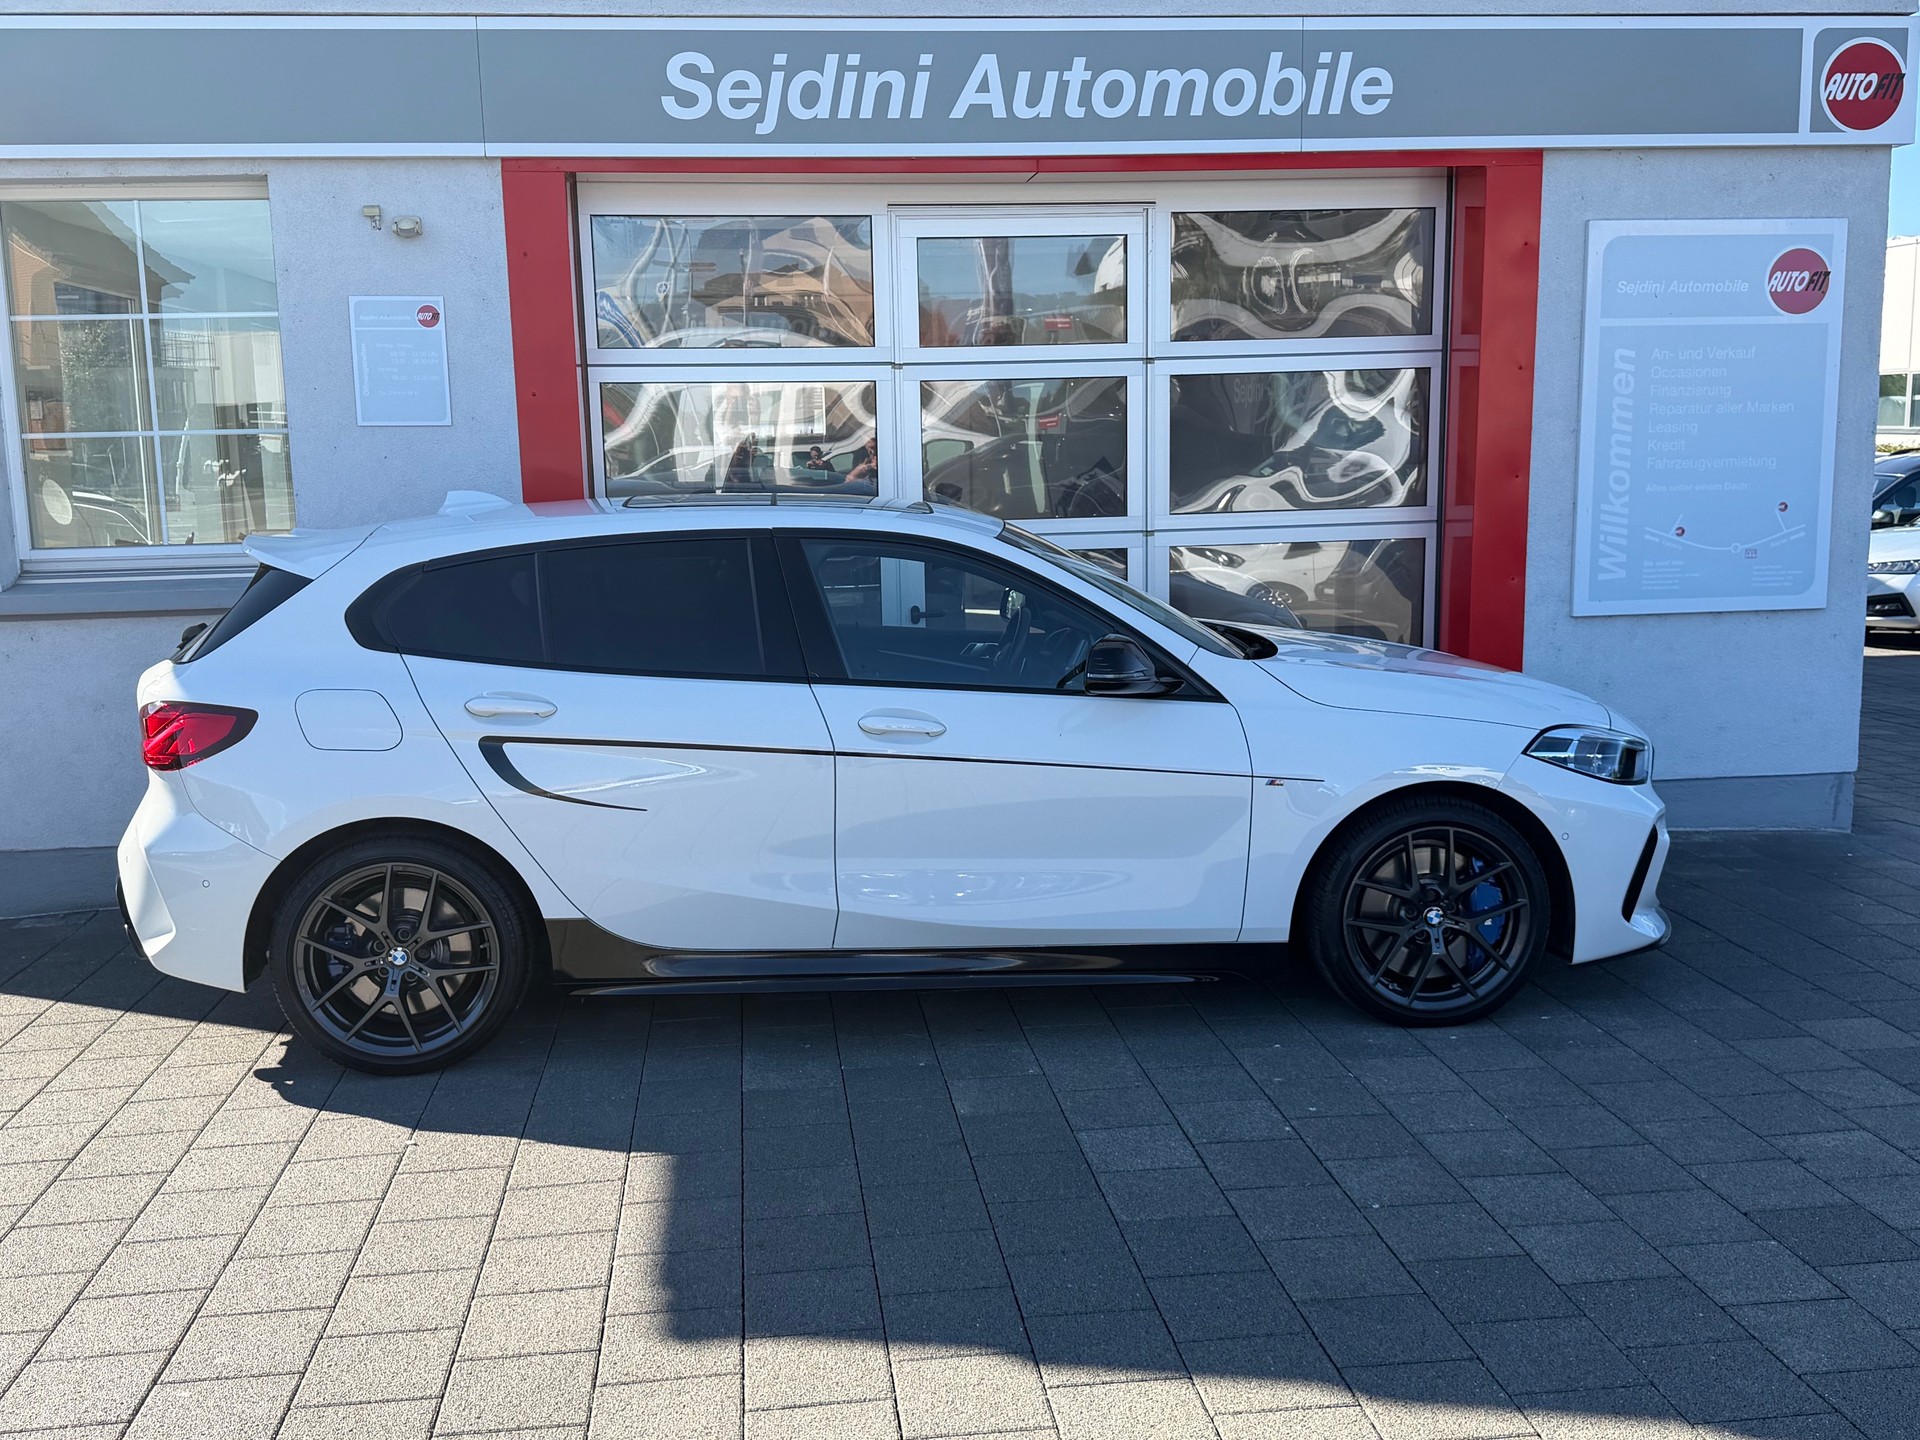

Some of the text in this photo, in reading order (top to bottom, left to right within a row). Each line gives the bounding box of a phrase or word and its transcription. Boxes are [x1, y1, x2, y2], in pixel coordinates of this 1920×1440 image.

[661, 51, 1394, 135] Sejdini Automobile
[1825, 72, 1906, 101] AUTOFIT
[1616, 279, 1749, 296] Sejdini Automobile
[1768, 270, 1831, 293] AUTOFIT
[1651, 345, 1757, 361] An- und Verkauf
[1650, 365, 1727, 378] Occasionen
[1650, 384, 1732, 398] Finanzierung
[1649, 400, 1795, 416] Reparatur aller Marken
[1648, 420, 1698, 435] Leasing
[1647, 439, 1686, 452] Kredit
[1597, 347, 1636, 581] Willkommen
[1646, 455, 1776, 472] Fahrzeugvermietung
